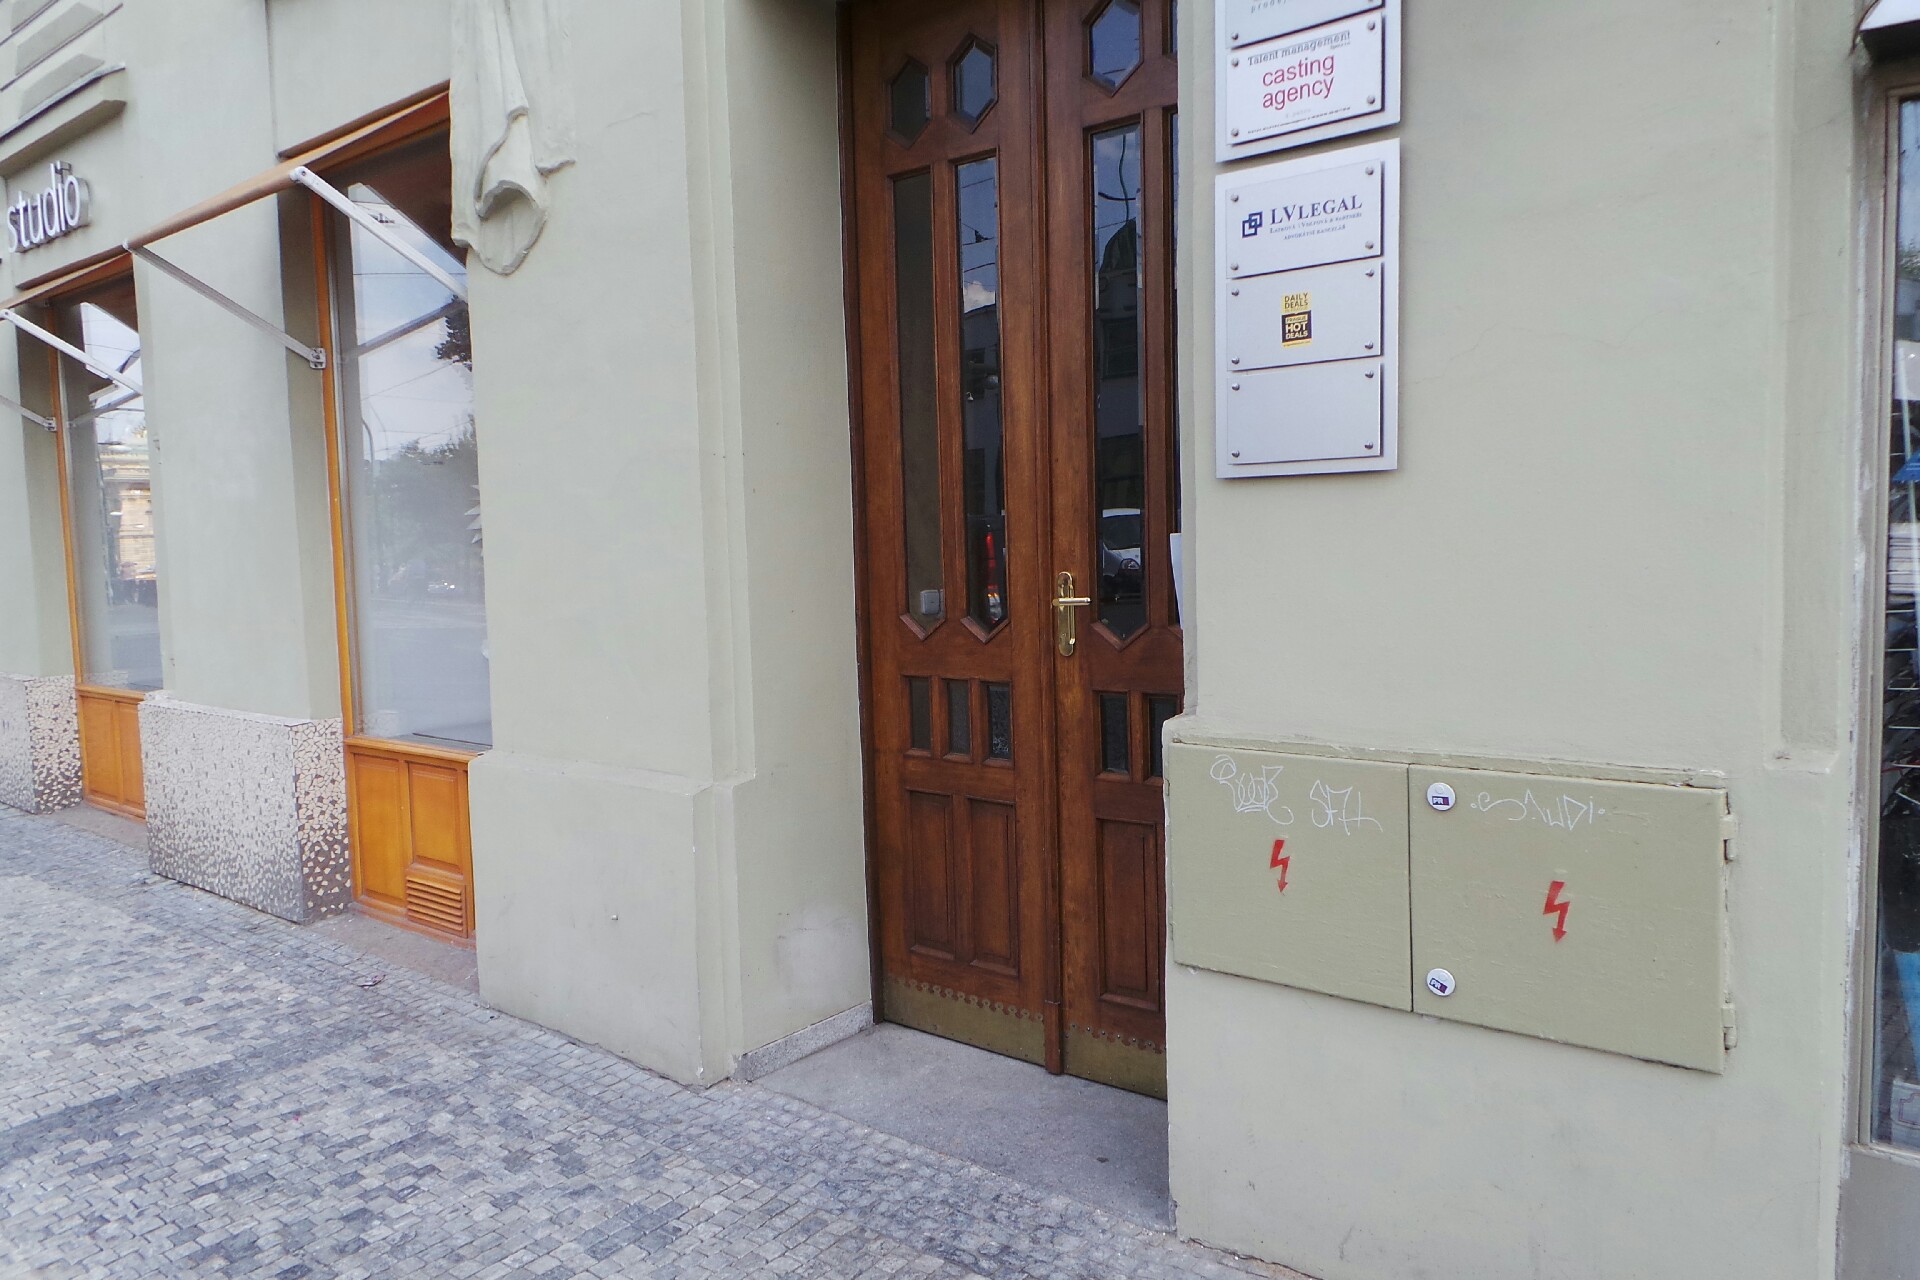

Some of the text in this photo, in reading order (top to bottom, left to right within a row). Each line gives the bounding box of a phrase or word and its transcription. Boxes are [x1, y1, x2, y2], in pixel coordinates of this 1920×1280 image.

[1248, 31, 1351, 66] Talent management
[1262, 55, 1335, 87] casting
[1262, 77, 1335, 111] agency
[7, 160, 81, 253] studio
[1270, 193, 1363, 225] LVLEGAL
[1284, 292, 1308, 303] DAILY
[1284, 300, 1308, 309] DEALS
[1285, 321, 1308, 333] HOT
[1285, 330, 1308, 339] DEALS
